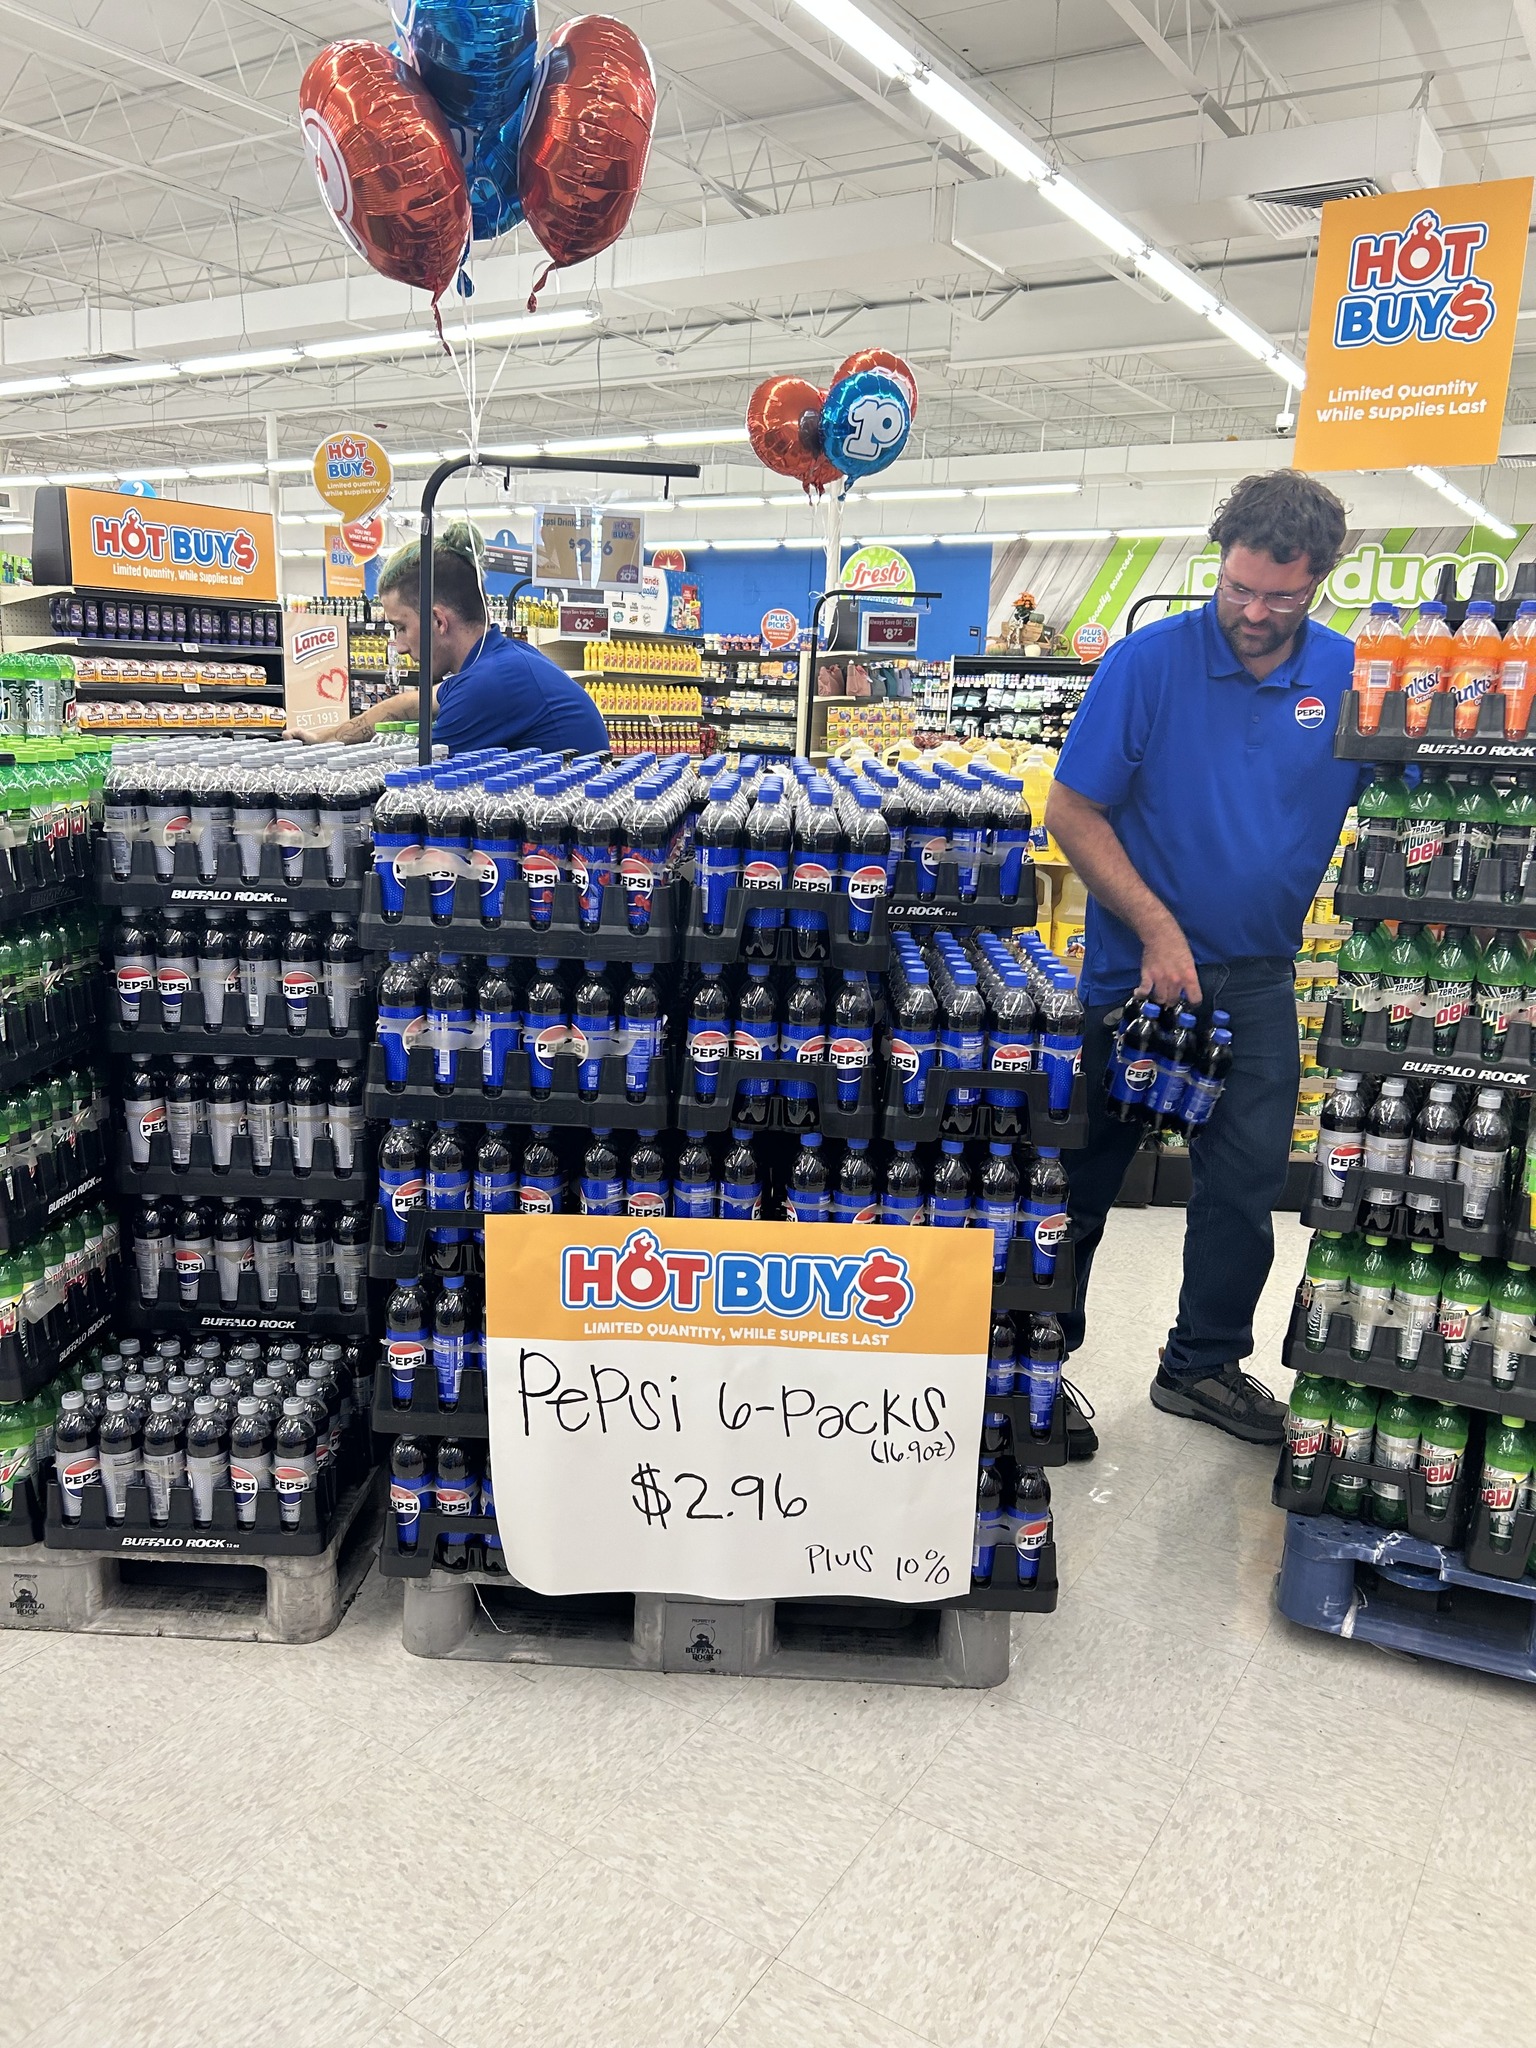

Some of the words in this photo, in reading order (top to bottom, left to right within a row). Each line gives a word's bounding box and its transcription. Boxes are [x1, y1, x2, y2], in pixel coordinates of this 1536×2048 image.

[1355, 217, 1480, 286] HOT
[1328, 385, 1393, 403] Limited
[1397, 380, 1478, 400] Quantity
[1316, 406, 1365, 422] While
[1369, 402, 1445, 421] Supplies
[1450, 399, 1488, 415] Last
[327, 437, 367, 460] HOT
[327, 482, 351, 490] Limited
[353, 480, 380, 490] Quantity
[324, 489, 343, 497] While
[344, 487, 372, 497] Supplies
[96, 513, 165, 557] HOT
[502, 531, 509, 547] 1
[112, 563, 142, 577] Limited
[143, 565, 177, 582] Quantity,
[178, 570, 198, 582] While
[199, 572, 228, 586] Supplies
[229, 575, 244, 586] Last
[846, 559, 906, 588] fresh
[770, 614, 789, 622] PLUS
[295, 631, 335, 654] Lance
[296, 713, 315, 727] EST.
[317, 711, 339, 725] 1913
[1297, 709, 1325, 718] PEPSI
[1417, 743, 1487, 755] BUFFALO
[1489, 745, 1536, 757] ROCK
[523, 873, 559, 885] PEPSI
[571, 873, 587, 886] PSI
[622, 877, 651, 888] EPSI
[744, 879, 780, 890] PEPSI
[793, 881, 830, 892] PEPSI
[851, 883, 885, 894] PEPS
[171, 890, 231, 902] BUFFALO
[234, 892, 273, 902] ROCK
[906, 906, 944, 916] ROCK
[118, 980, 152, 990] PEPSI
[157, 982, 190, 991] PEPSI
[284, 985, 317, 995] PEPSI
[692, 1046, 729, 1058] PEPSI
[801, 1053, 824, 1064] PEP
[831, 1053, 868, 1066] PEPSI
[891, 1056, 917, 1069] EPSI
[994, 1060, 1031, 1072] PEPSI
[1402, 1061, 1475, 1078] BUFFALO
[1478, 1071, 1530, 1085] ROCK
[143, 1122, 168, 1132] PEP
[1331, 1157, 1361, 1167] PEPS
[77, 1176, 96, 1195] ROCK
[395, 1195, 425, 1207] PEP
[629, 1207, 665, 1217] PEPSI
[1038, 1231, 1067, 1241] PEP
[569, 1236, 704, 1303] HOT
[87, 1315, 105, 1337] ROCK
[201, 1317, 257, 1328] BUFFALO
[259, 1319, 296, 1330] ROCK
[584, 1322, 644, 1335] LIMITED
[647, 1323, 726, 1340] QUANTITY,
[729, 1327, 776, 1340] WHILE
[779, 1330, 850, 1345] SUPPLIES
[852, 1333, 889, 1346] LAST
[389, 1354, 425, 1366] PEPSI
[65, 1471, 99, 1486] PEPS
[231, 1482, 255, 1491] EPSI
[631, 1463, 807, 1529] $2.96
[391, 1500, 418, 1511] EPSI
[437, 1502, 470, 1512] PEPSI
[121, 1537, 183, 1547] BUFFALO
[186, 1538, 227, 1548] ROCK
[1018, 1534, 1047, 1546] PEPS
[896, 1549, 950, 1585] 10%
[685, 1647, 722, 1655] BUFFALO
